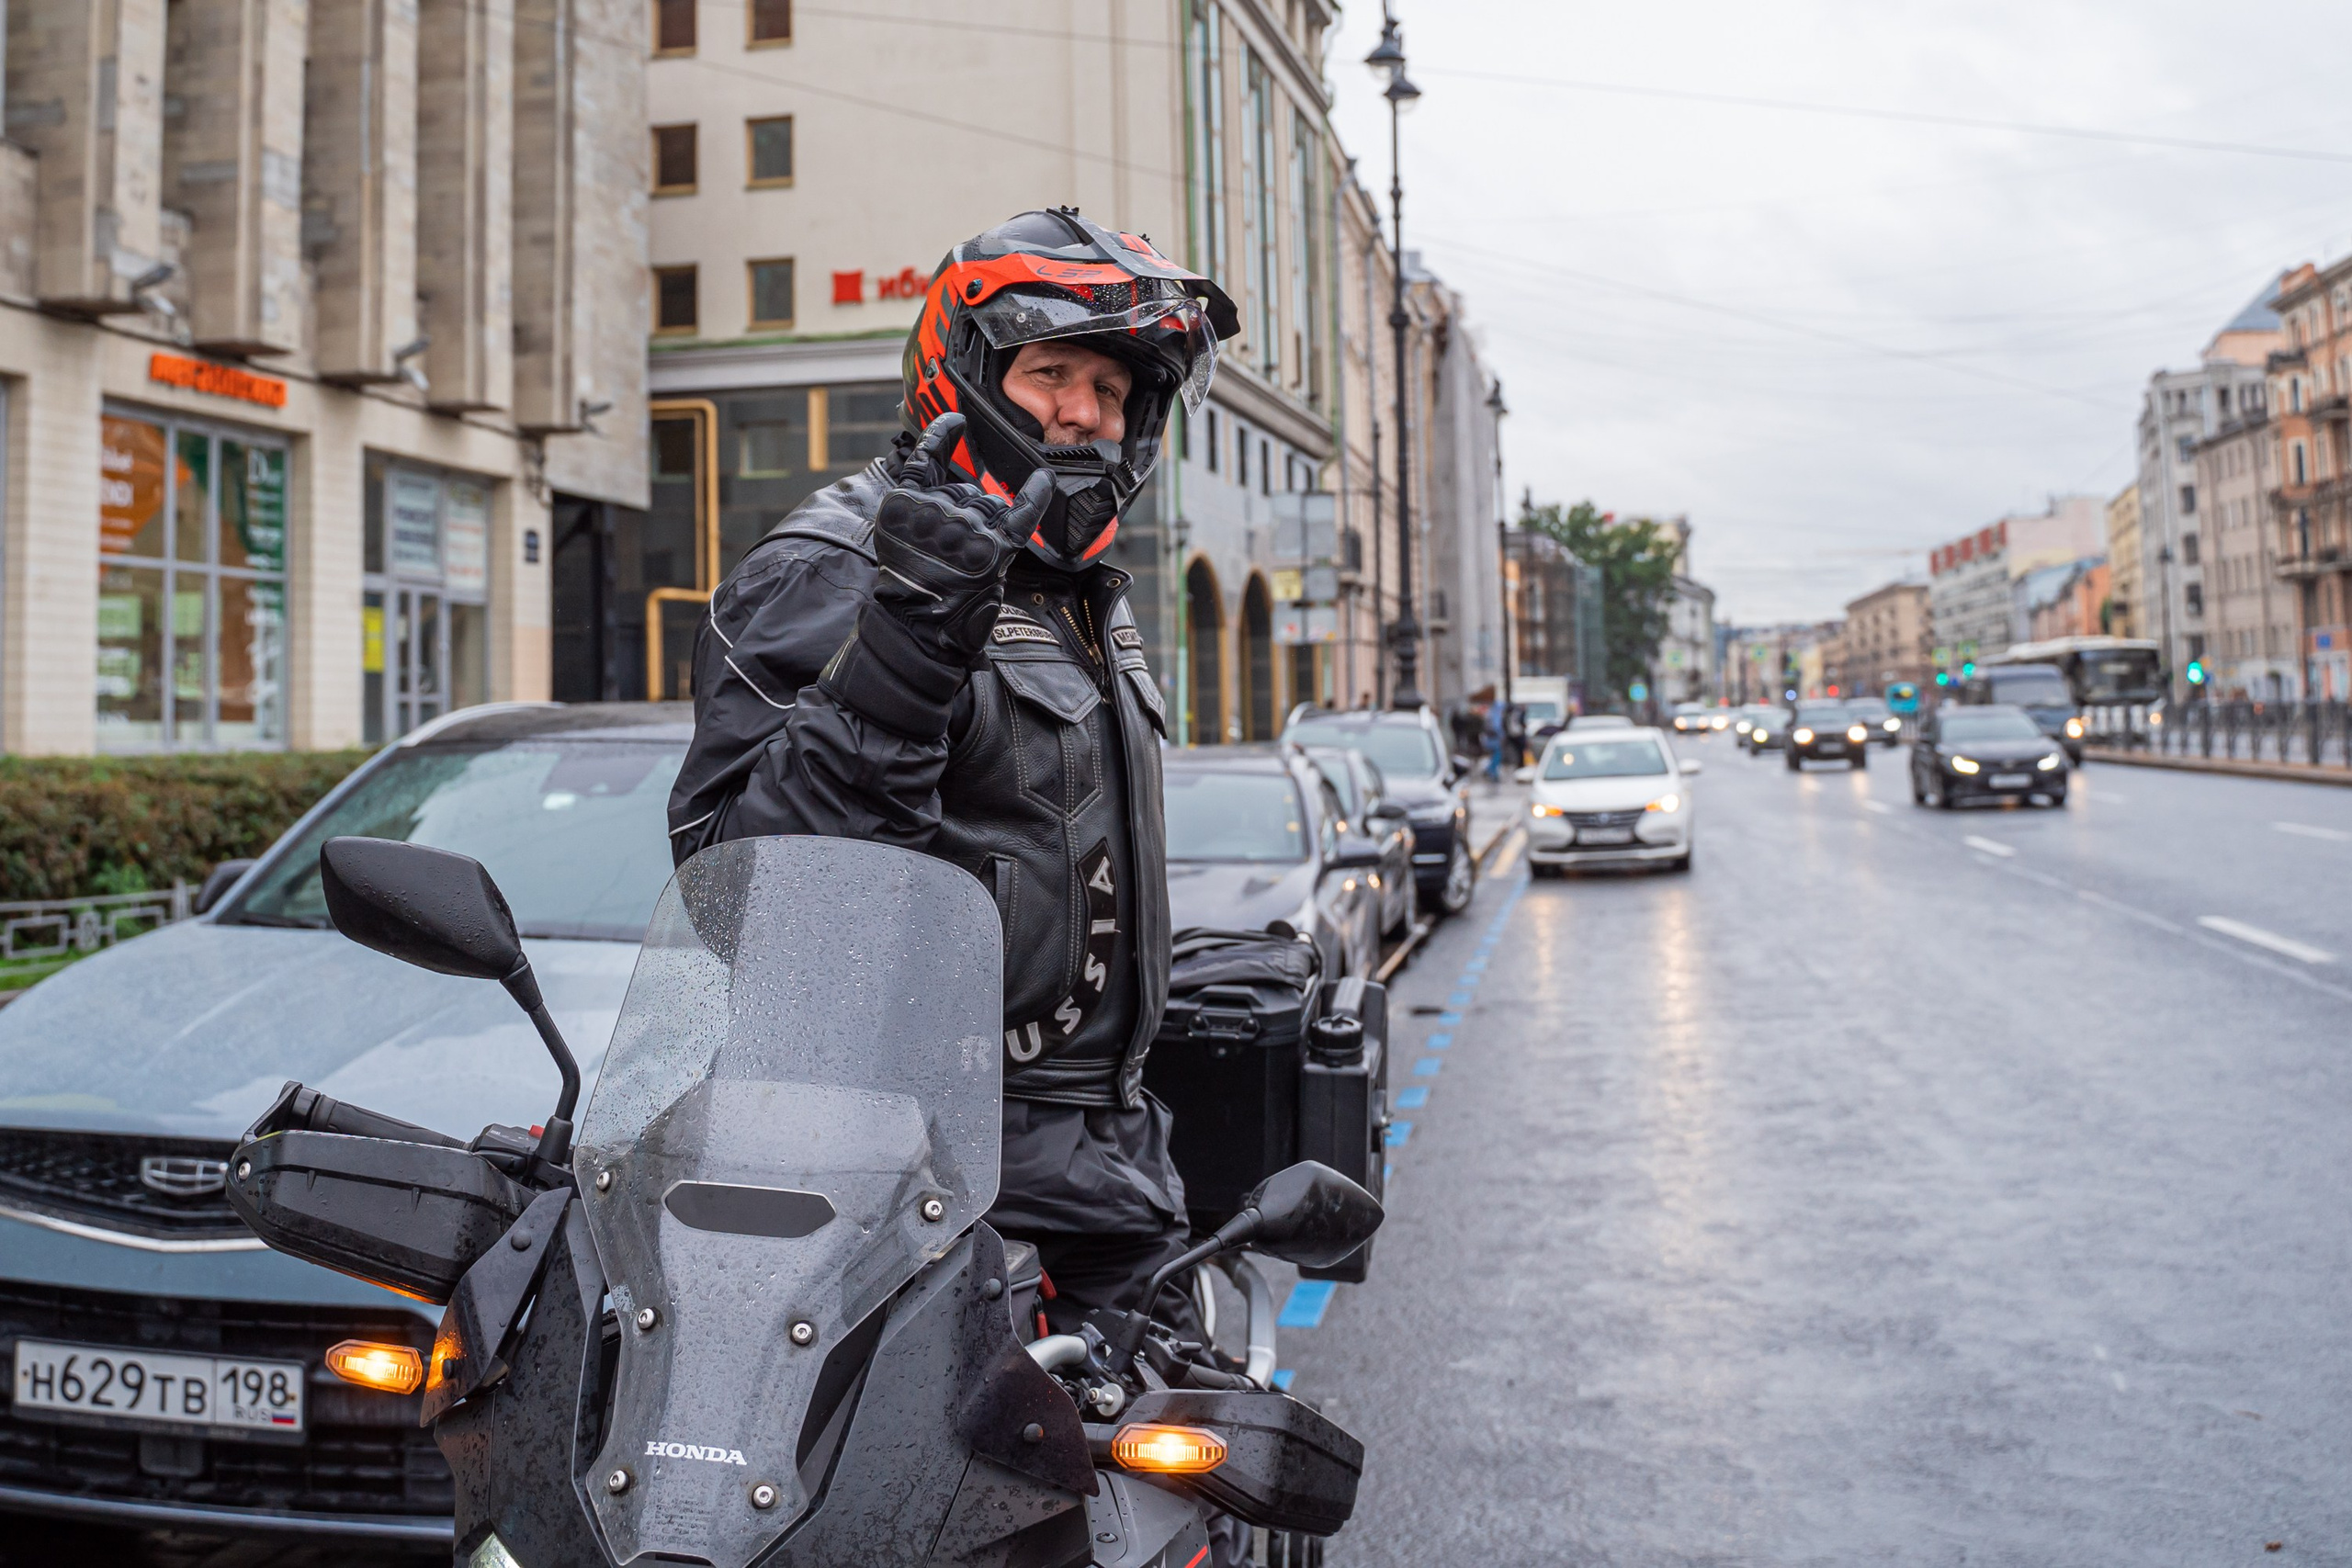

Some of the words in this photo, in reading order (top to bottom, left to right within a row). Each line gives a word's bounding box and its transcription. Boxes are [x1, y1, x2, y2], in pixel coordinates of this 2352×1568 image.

[30, 1354, 208, 1415] Н629ТВ
[221, 1367, 289, 1406] 198
[232, 1404, 271, 1423] RUS
[644, 1440, 748, 1466] HONDA
